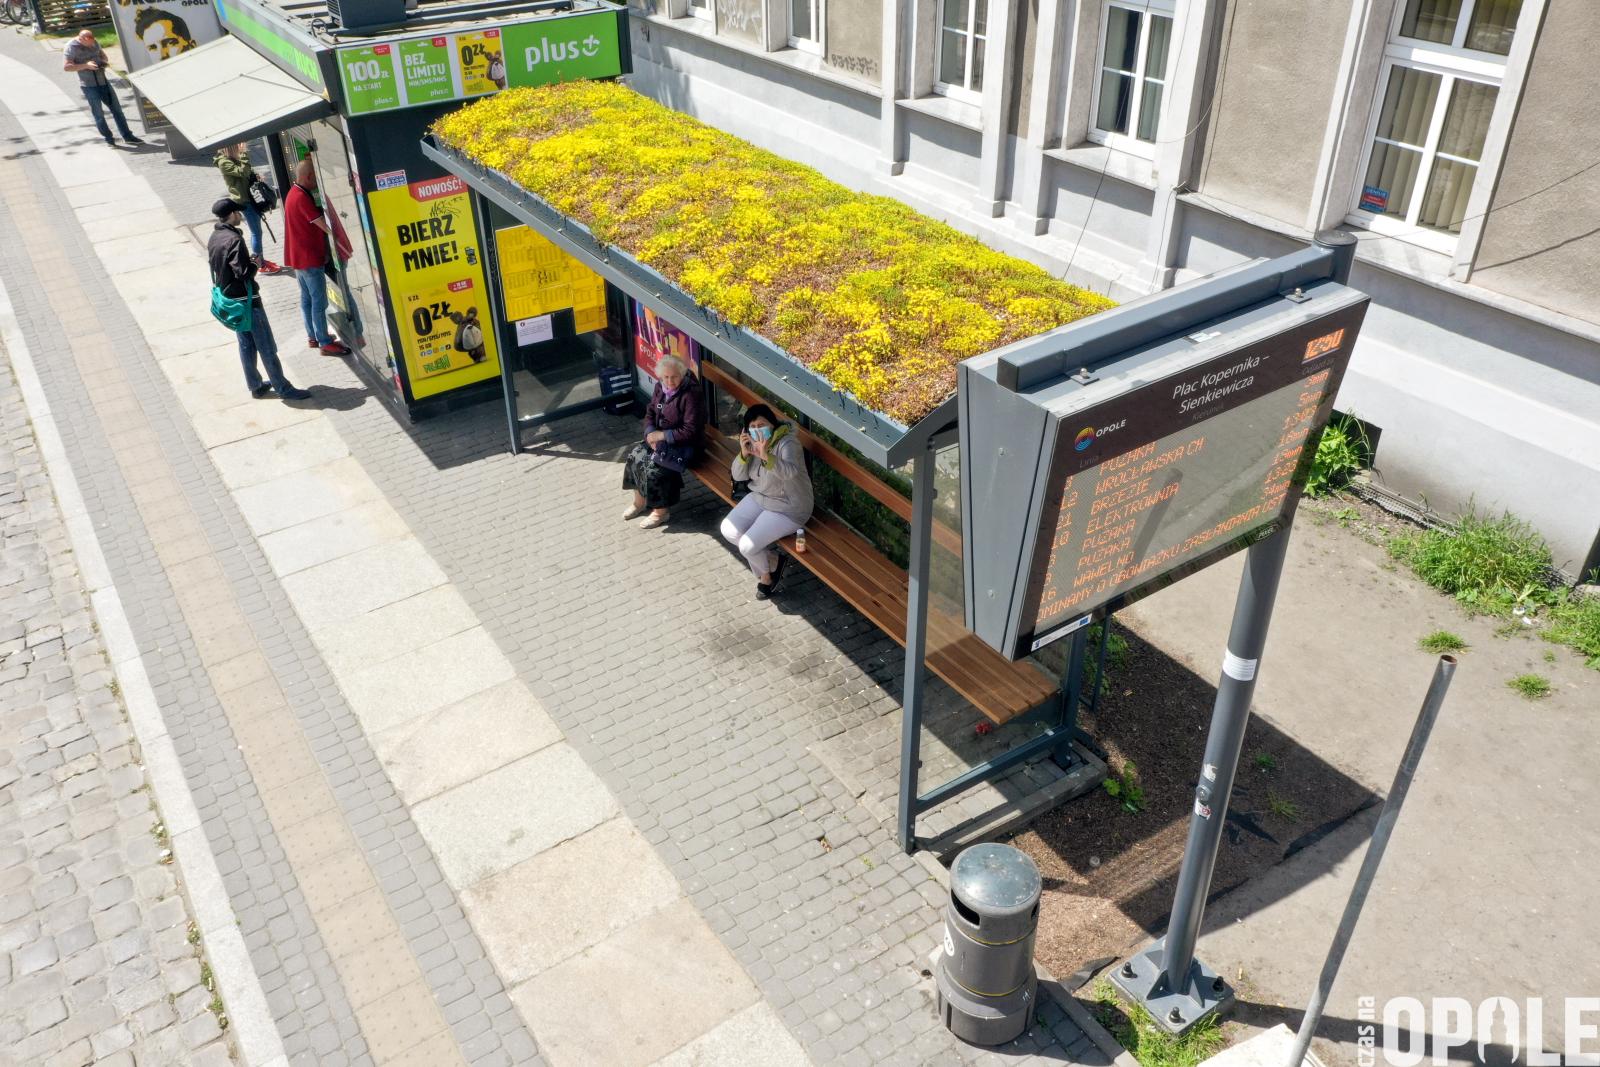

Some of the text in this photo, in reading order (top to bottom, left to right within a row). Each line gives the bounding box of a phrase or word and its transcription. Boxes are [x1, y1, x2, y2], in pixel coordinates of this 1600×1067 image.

[404, 53, 425, 66] BEZ
[525, 37, 580, 72] plus
[347, 60, 381, 82] 100
[407, 63, 446, 80] LIMITU
[418, 178, 462, 198] NOWOŚĆ!
[396, 213, 455, 246] BIERZ
[402, 240, 459, 272] MNIE!
[1172, 381, 1199, 400] Plac
[1200, 355, 1260, 388] Kopernika
[1178, 375, 1254, 414] Sienkiewicza
[1095, 419, 1127, 437] OPOLE
